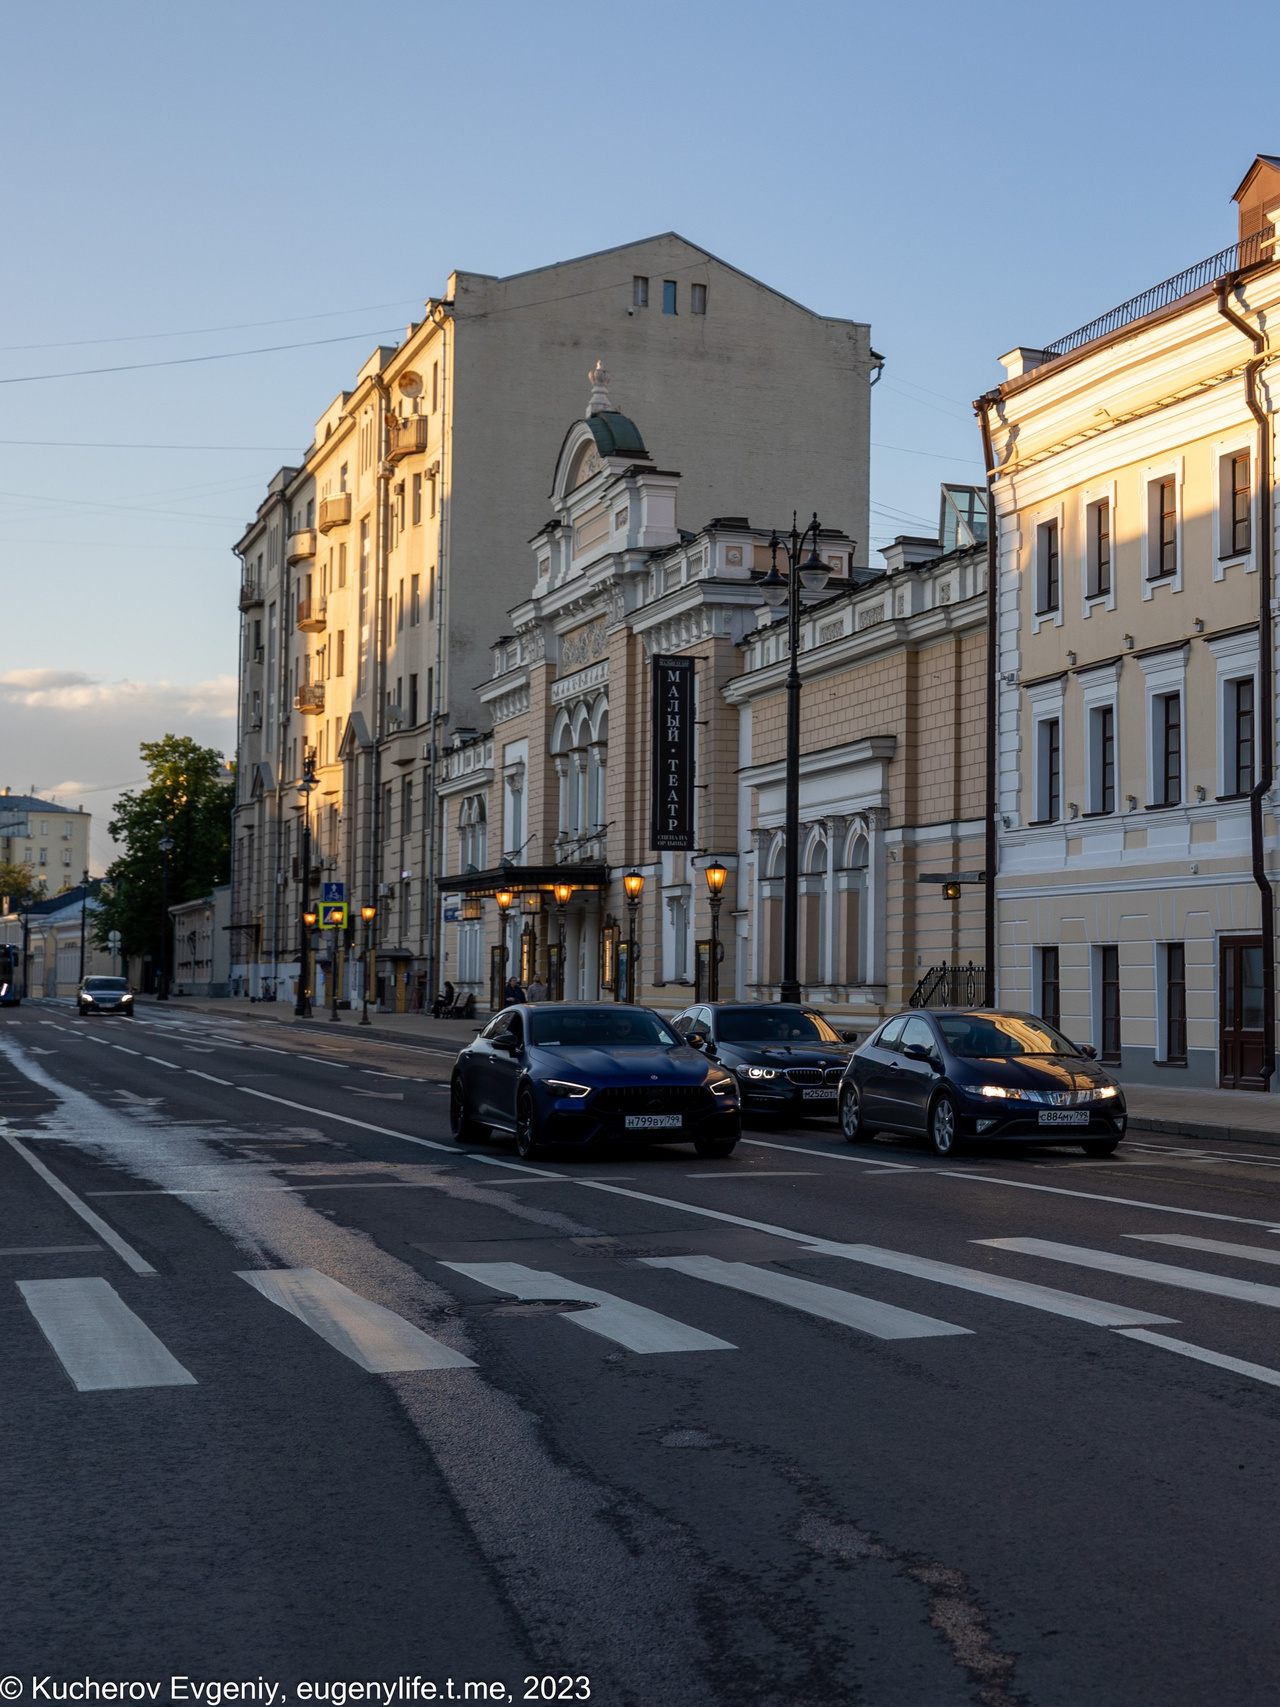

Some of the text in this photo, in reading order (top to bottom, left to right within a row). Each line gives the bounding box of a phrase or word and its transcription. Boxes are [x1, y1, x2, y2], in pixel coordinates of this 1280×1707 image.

[667, 670, 681, 742] МАЛЫЙ
[667, 759, 679, 831] ТЕАТР
[628, 1115, 680, 1127] Н799ВУ 799
[1040, 1112, 1074, 1122] С884МУ
